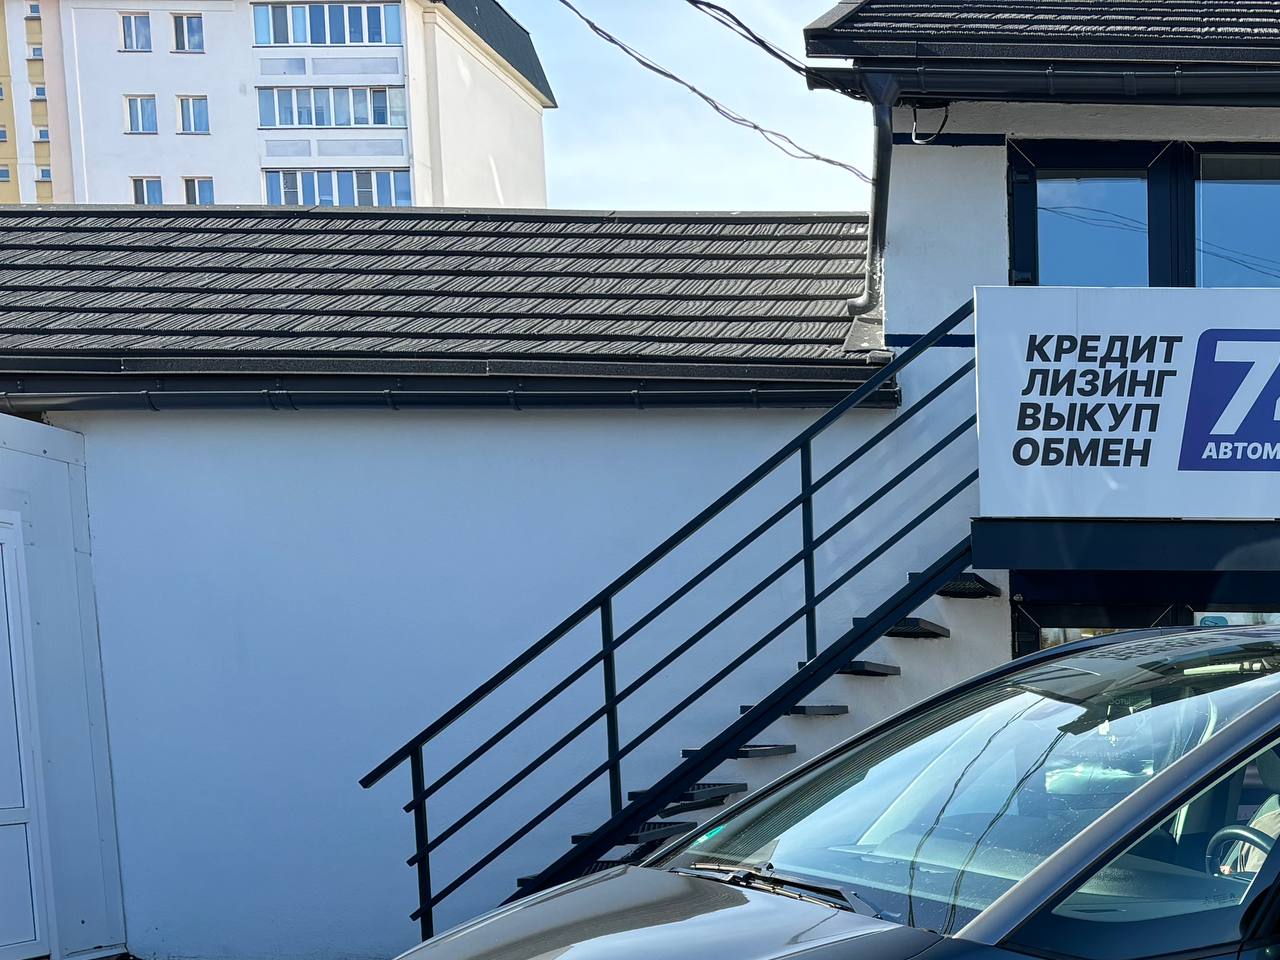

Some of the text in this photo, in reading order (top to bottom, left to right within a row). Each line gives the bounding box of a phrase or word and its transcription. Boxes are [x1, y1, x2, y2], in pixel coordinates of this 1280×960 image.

[1025, 334, 1183, 370] КРЕДИТ
[1021, 368, 1178, 398] ЛИЗИНГ
[1016, 402, 1159, 433] ВЫКУП
[1012, 436, 1152, 467] ОБМЕН
